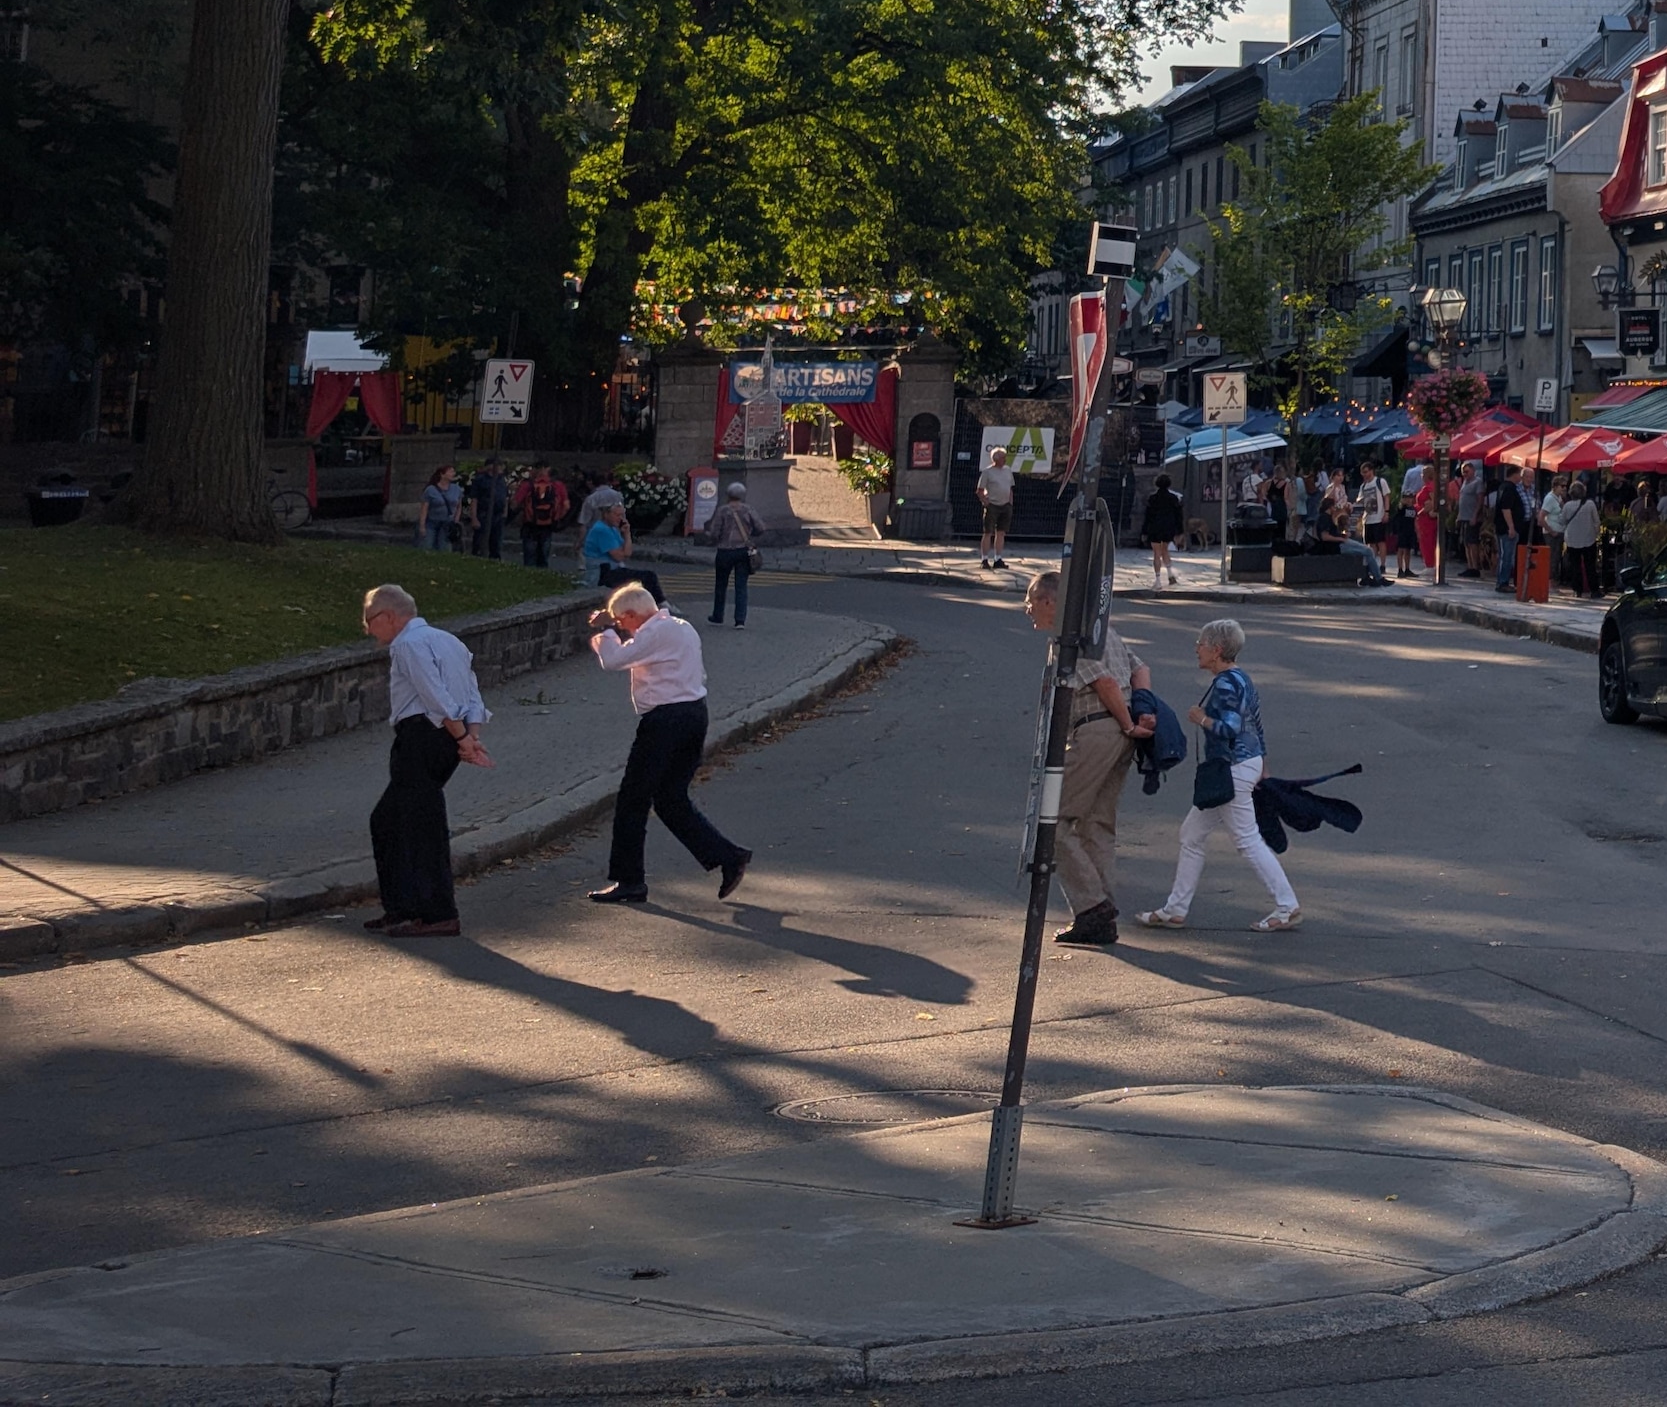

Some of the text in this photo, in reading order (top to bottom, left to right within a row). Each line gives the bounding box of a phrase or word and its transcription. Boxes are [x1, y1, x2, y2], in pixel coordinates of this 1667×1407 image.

[775, 368, 874, 387] ARTISANS
[782, 384, 866, 397] de la Cathédrale
